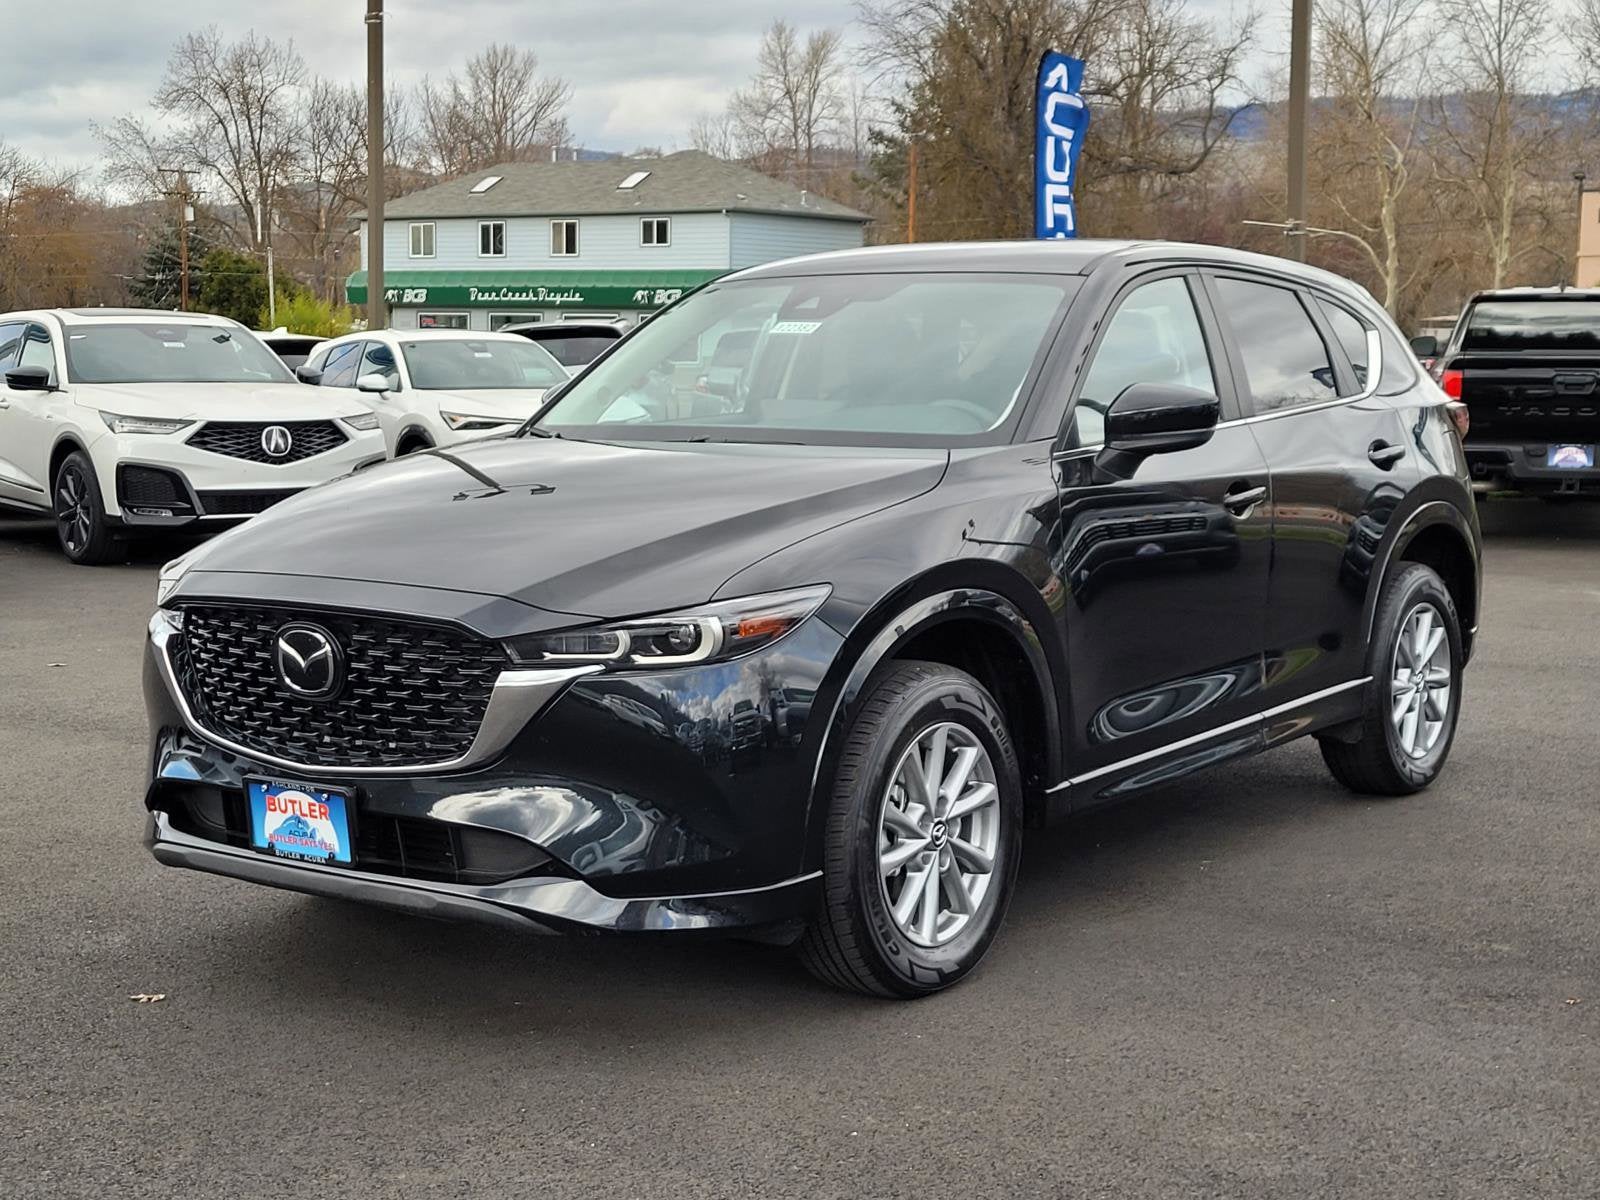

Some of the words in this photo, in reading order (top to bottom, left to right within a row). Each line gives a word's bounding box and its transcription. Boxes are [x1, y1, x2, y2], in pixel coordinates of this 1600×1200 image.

[1044, 62, 1084, 239] ACUR
[469, 287, 499, 301] Bear
[500, 287, 537, 301] Creek
[537, 287, 584, 305] Bicycle
[266, 796, 330, 820] BUTLER
[269, 833, 298, 845] BUTLER
[288, 830, 315, 839] ACURA
[275, 850, 301, 860] BUTLER
[303, 853, 327, 864] ACURA
